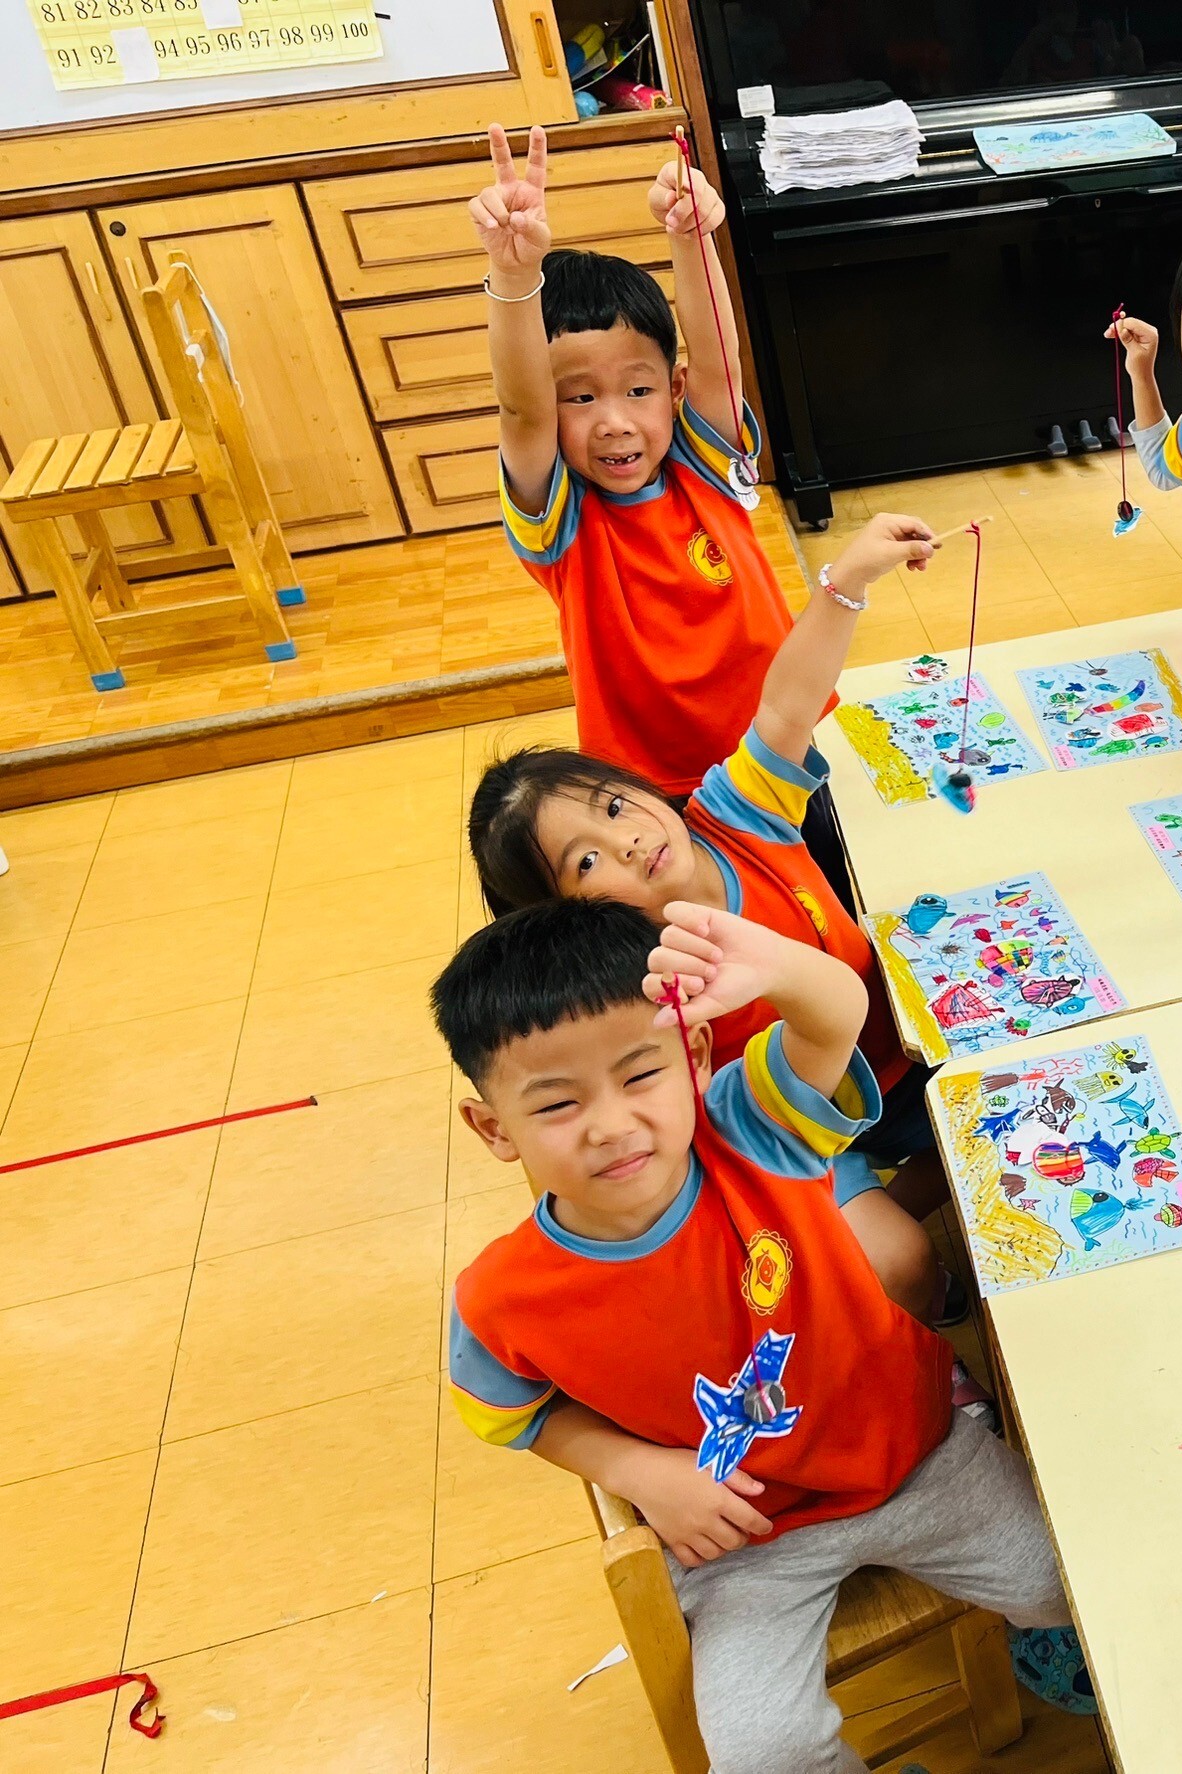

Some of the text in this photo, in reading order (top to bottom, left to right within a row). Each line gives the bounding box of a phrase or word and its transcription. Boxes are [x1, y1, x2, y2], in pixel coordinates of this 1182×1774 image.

[41, 3, 67, 23] 81
[74, 0, 102, 20] 82
[109, 0, 134, 17] 83
[142, 0, 166, 14] 84
[57, 22, 369, 69] 91 92 94 95 96 97 98 99 100
